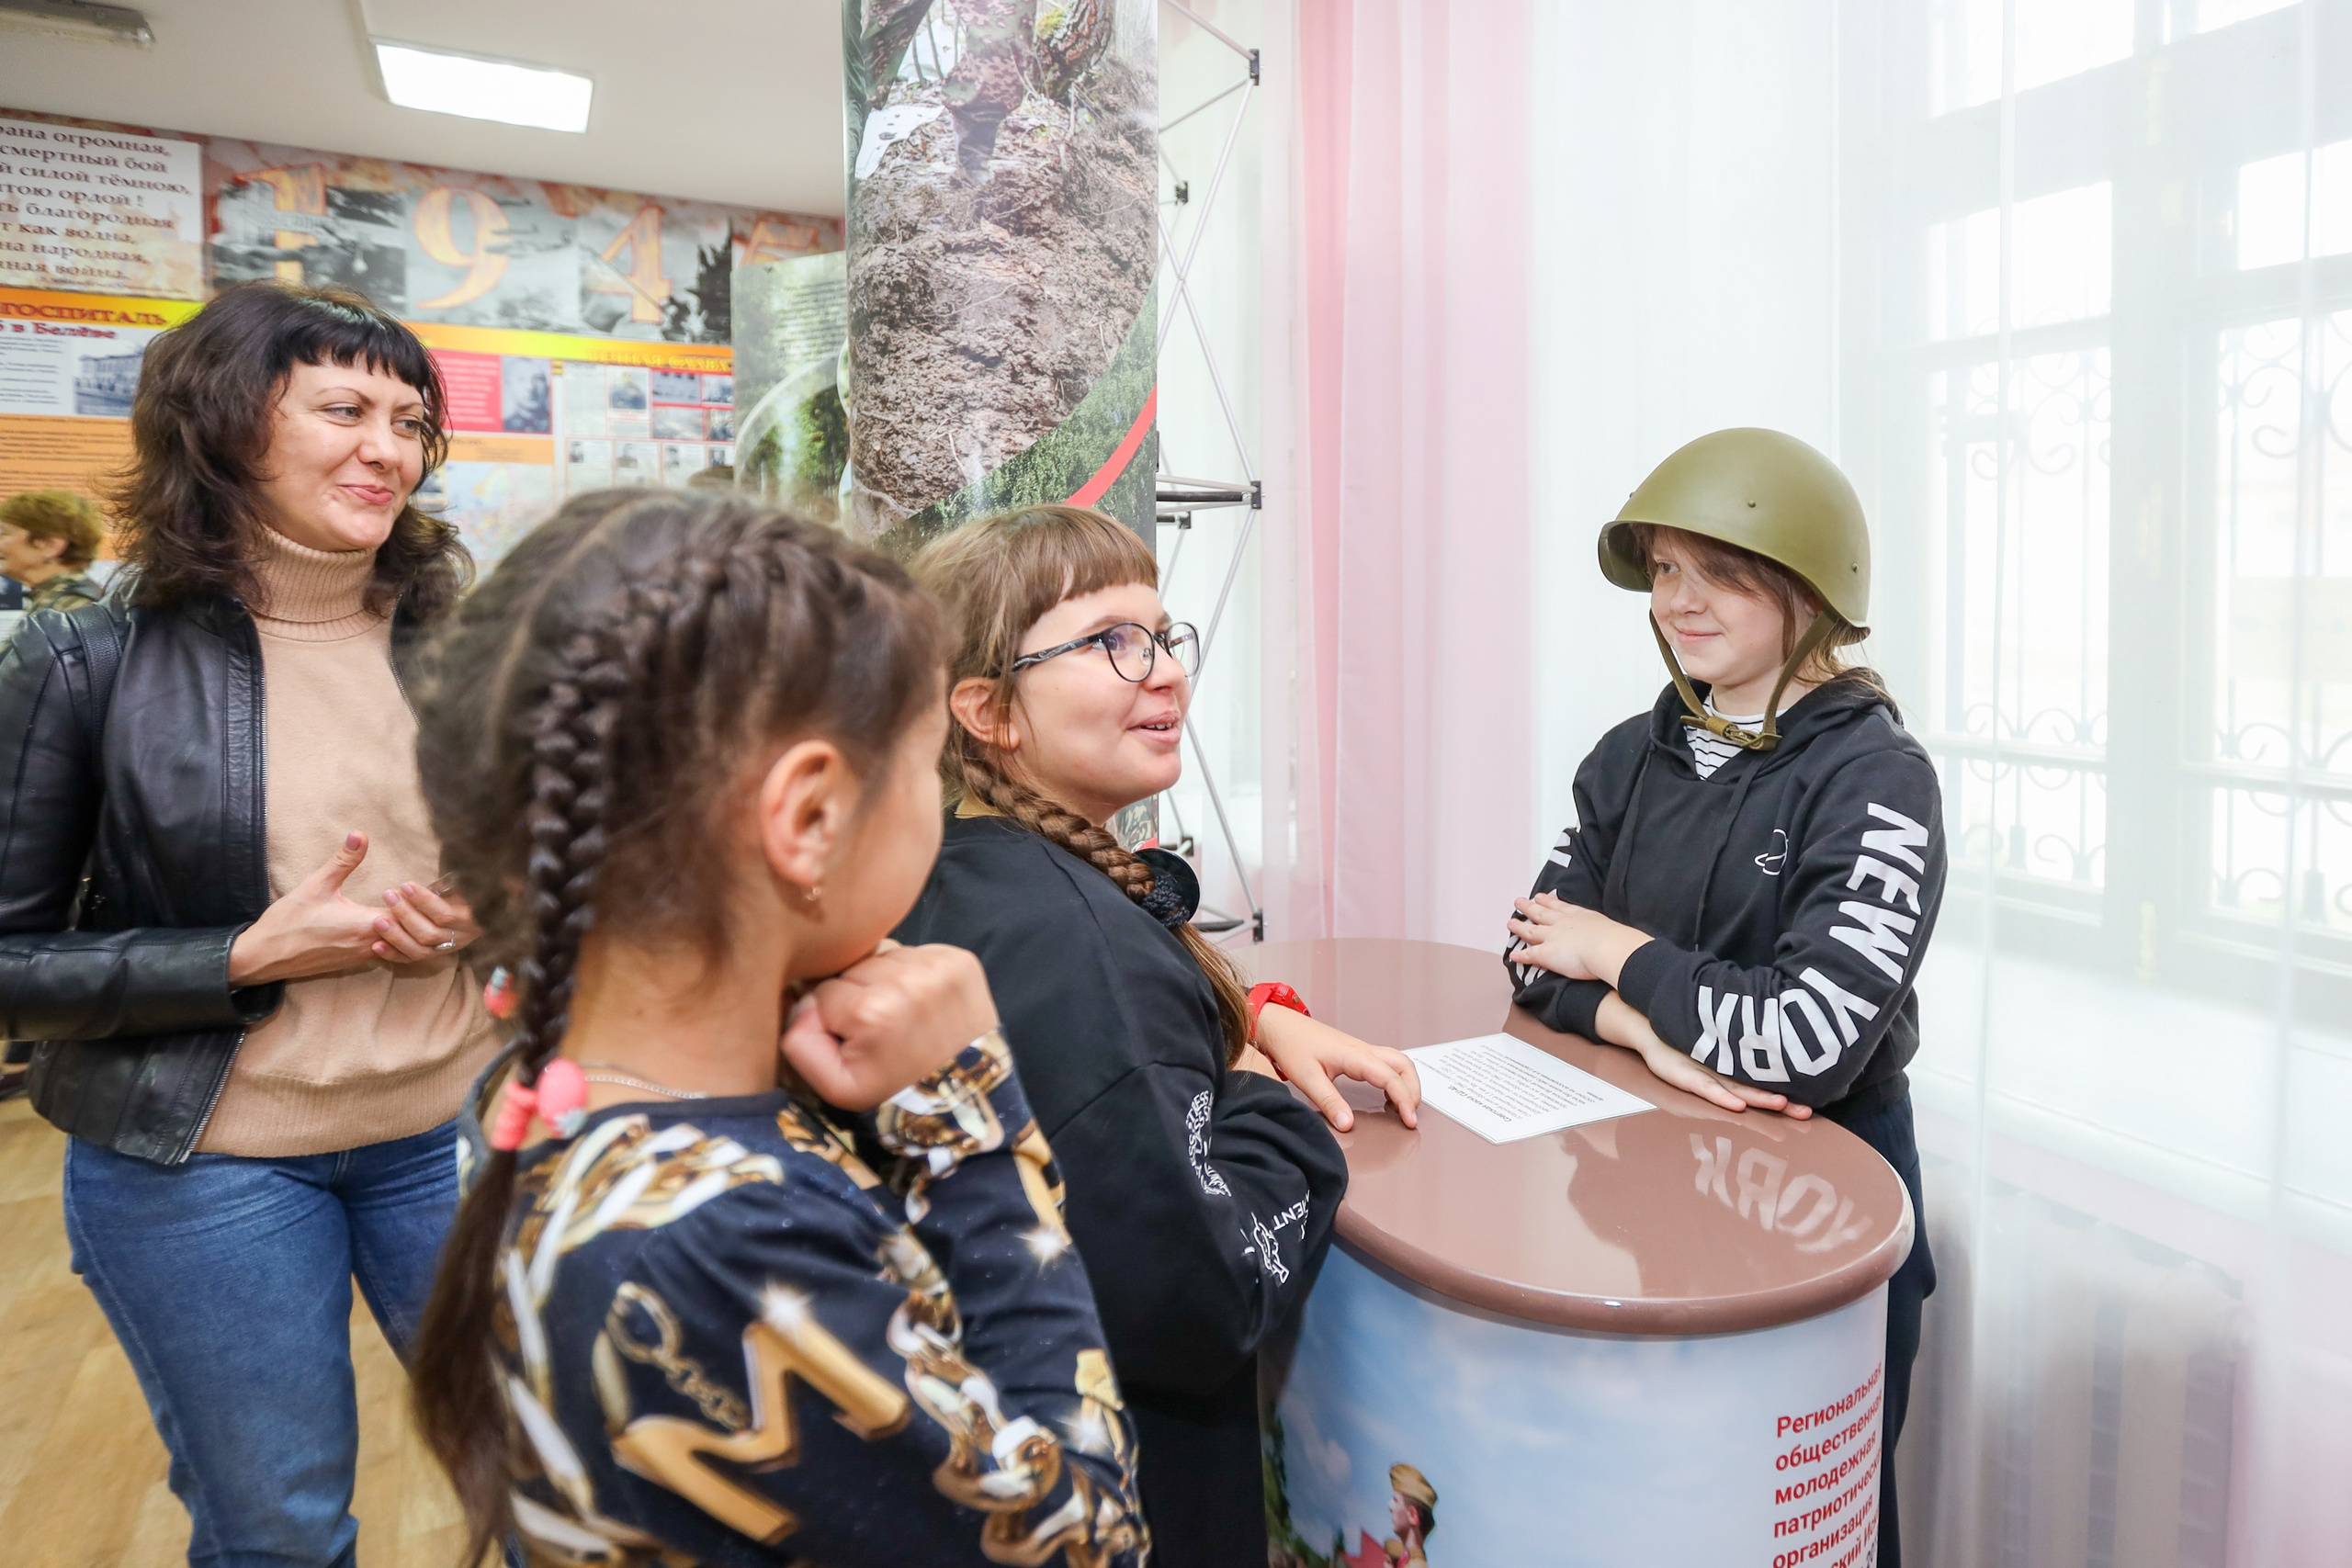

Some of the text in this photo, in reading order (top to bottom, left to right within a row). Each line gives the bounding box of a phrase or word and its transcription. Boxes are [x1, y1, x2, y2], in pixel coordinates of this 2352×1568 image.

[0, 144, 168, 174] смертный бой
[19, 166, 91, 183] силой
[95, 173, 192, 196] тёмною,
[52, 131, 172, 157] огромная,
[18, 223, 60, 236] как
[26, 202, 176, 230] благородная
[59, 189, 131, 208] ордой
[1829, 802, 1929, 985] NEW
[1690, 966, 1881, 1084] YORK
[1775, 1388, 1882, 1472] общественная
[1777, 1360, 1882, 1438] Региональная
[1774, 1448, 1882, 1539] патриотическ
[1775, 1430, 1876, 1506] молодежная
[1772, 1494, 1872, 1568] организация
